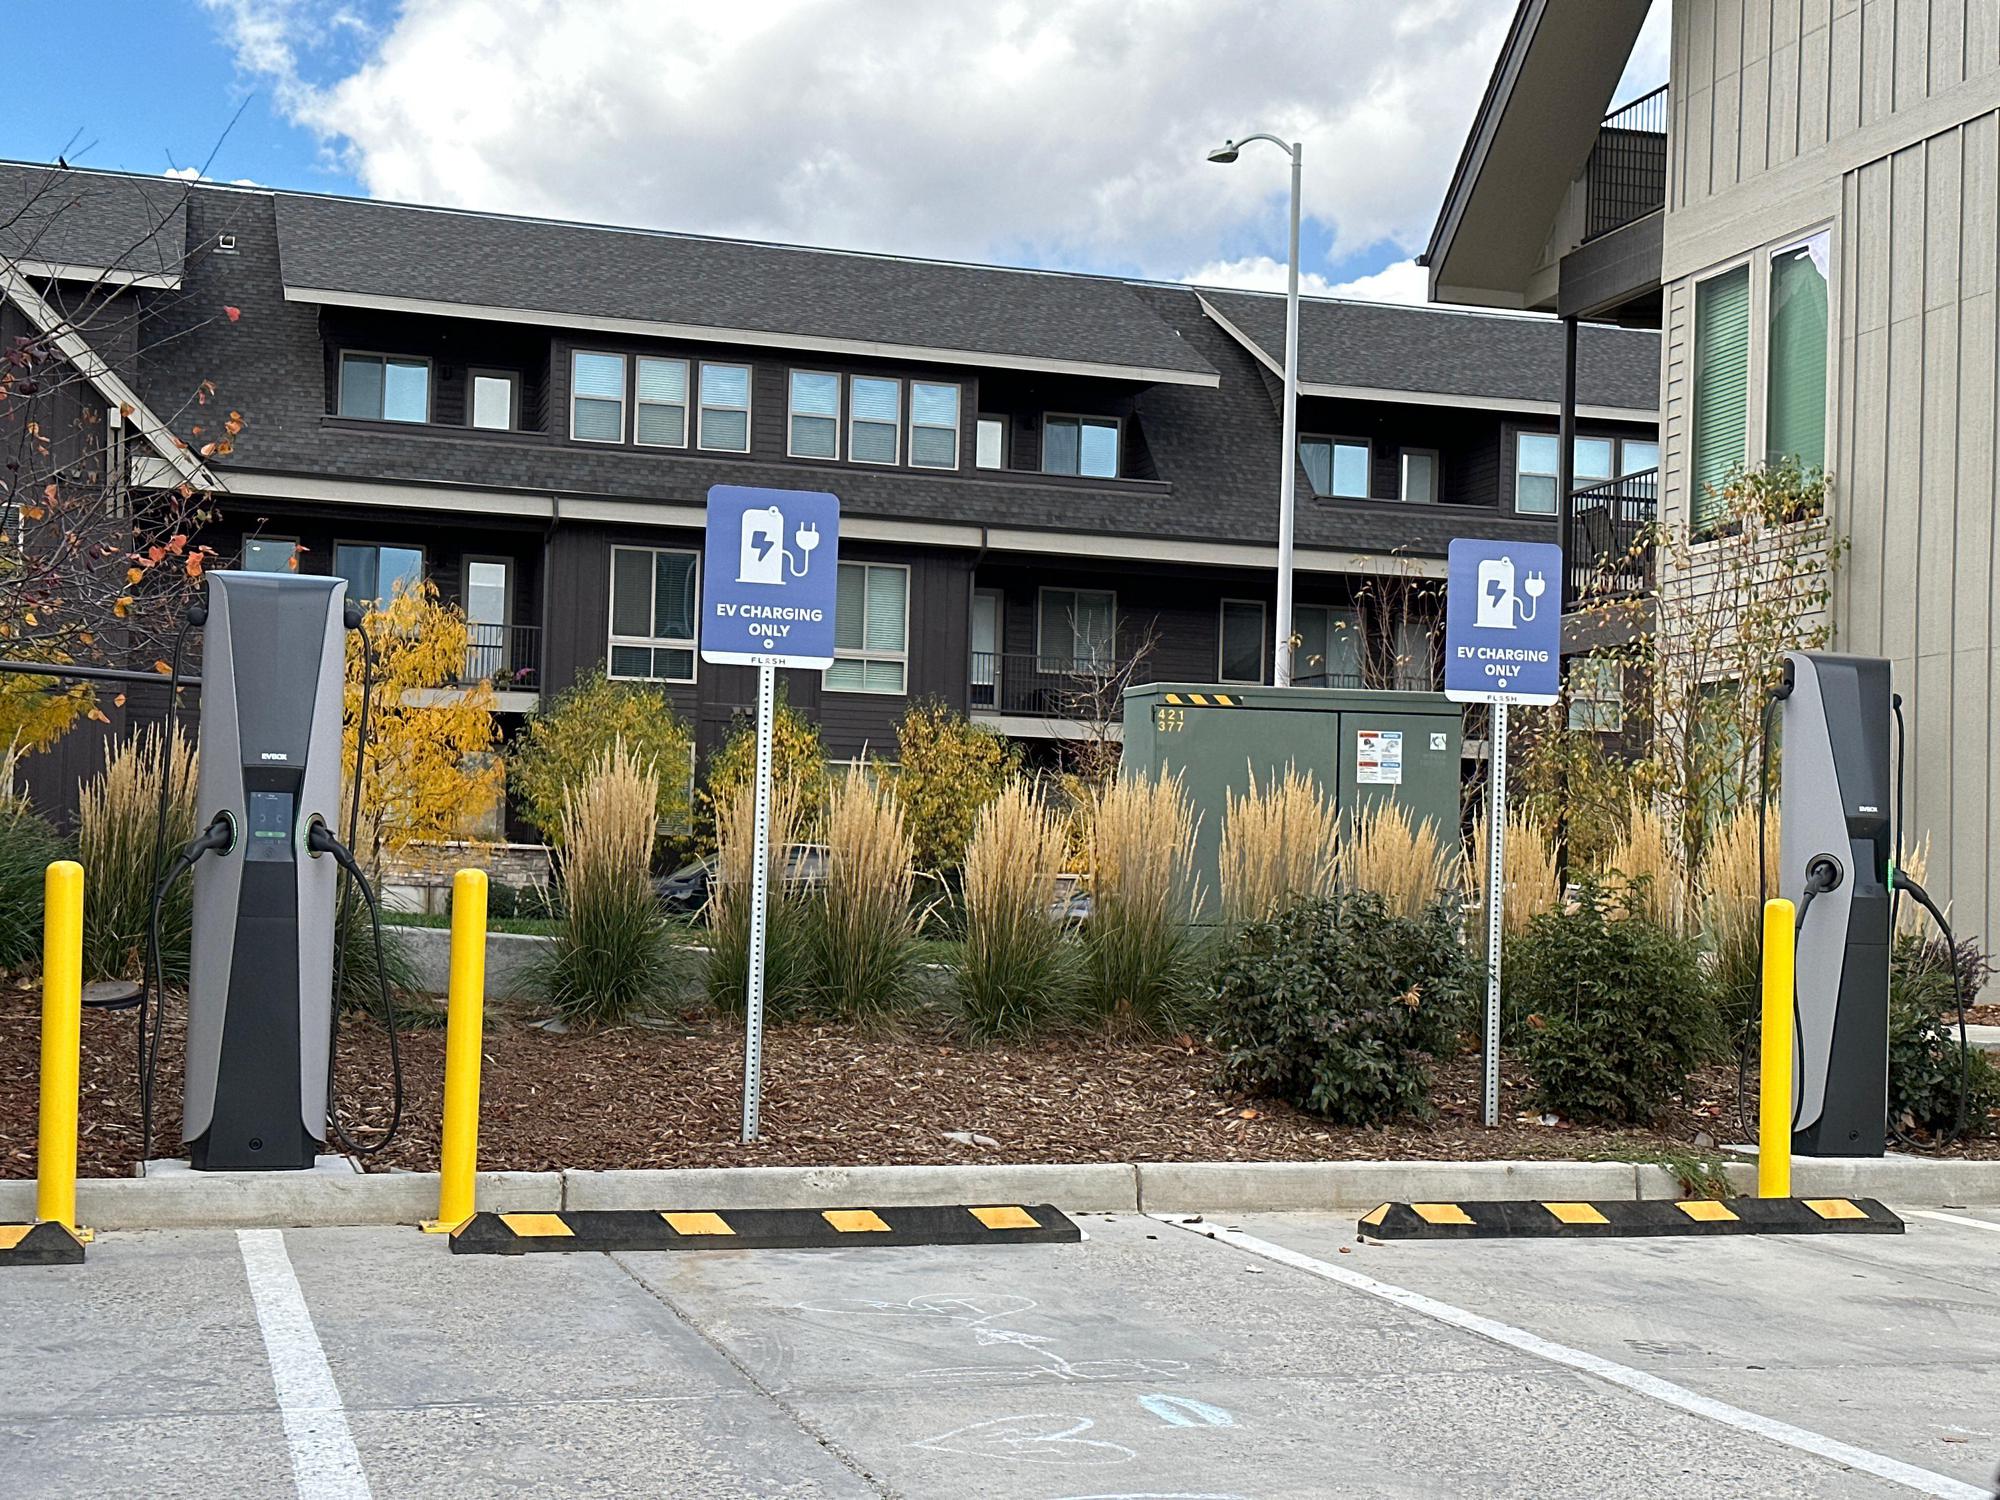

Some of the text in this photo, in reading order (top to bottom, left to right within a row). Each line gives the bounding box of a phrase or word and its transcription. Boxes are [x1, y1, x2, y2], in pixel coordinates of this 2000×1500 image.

[716, 603, 823, 621] EV CHARGING
[748, 623, 791, 638] ONLY
[1457, 646, 1548, 662] EV CHARGING
[1484, 664, 1521, 678] ONLY
[1158, 708, 1184, 721] 421
[1158, 720, 1184, 733] 377
